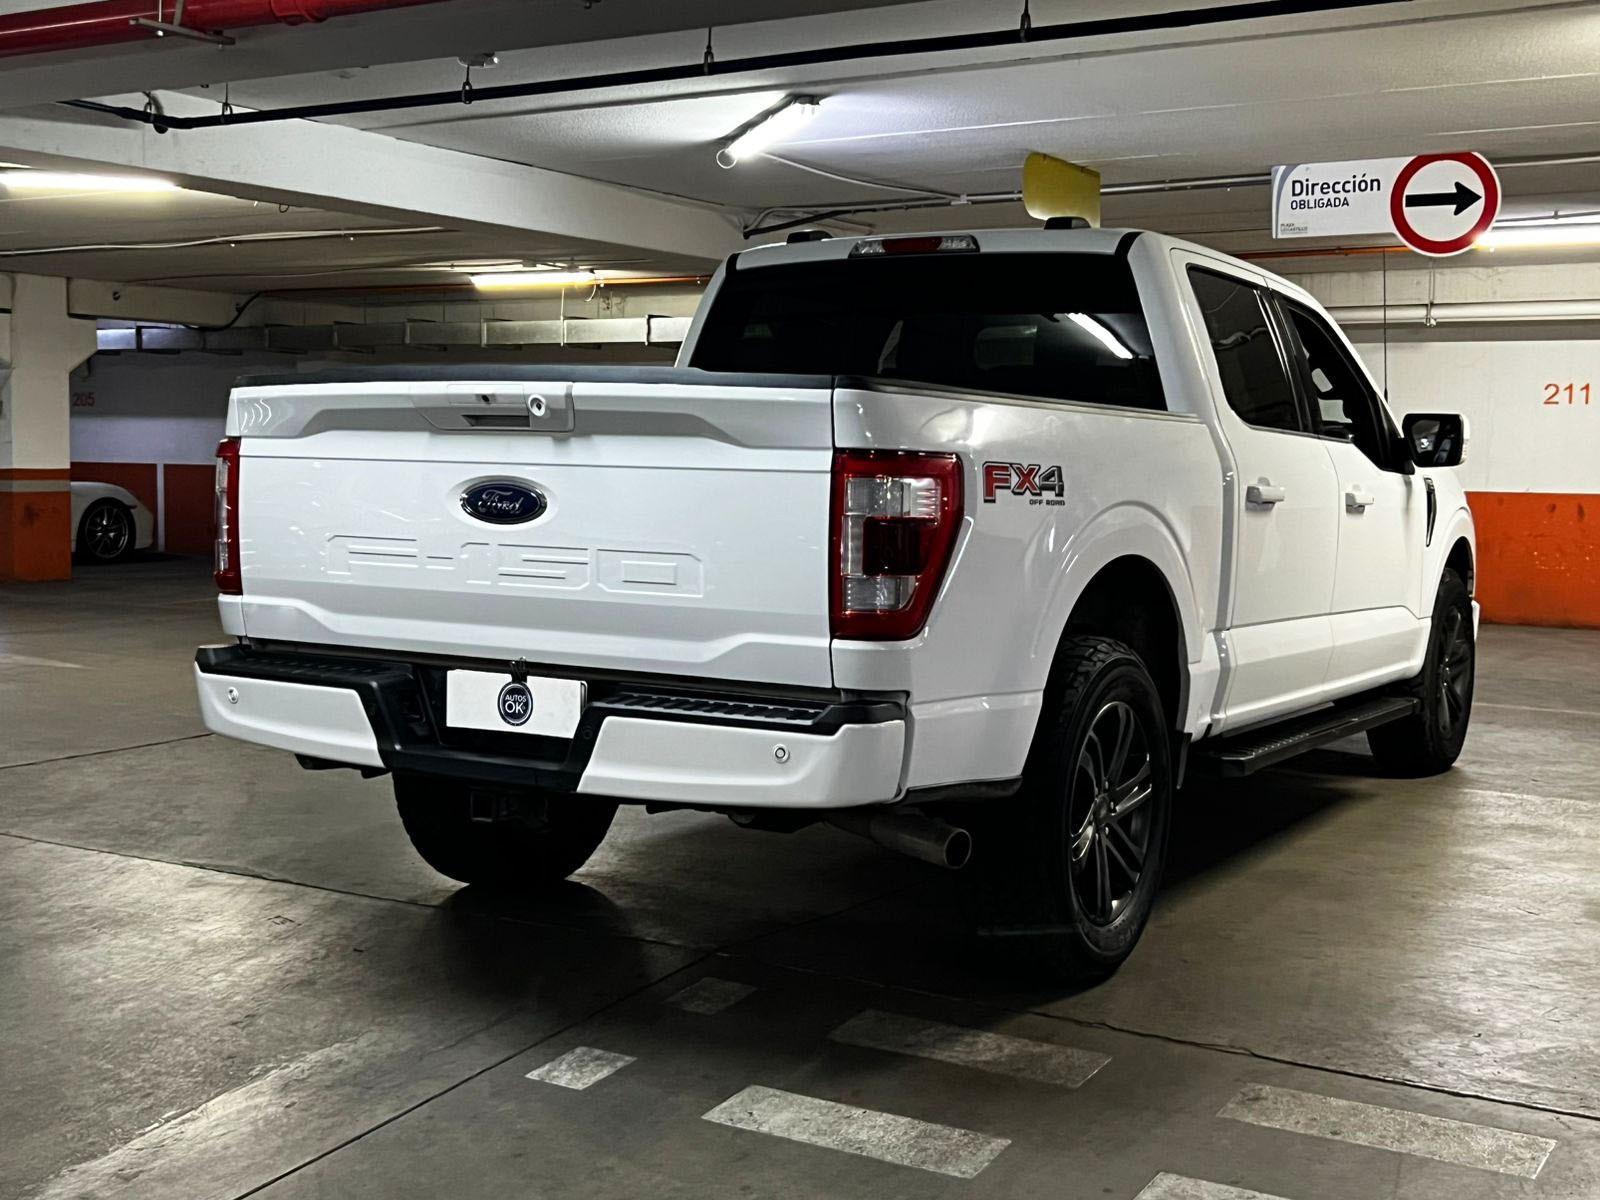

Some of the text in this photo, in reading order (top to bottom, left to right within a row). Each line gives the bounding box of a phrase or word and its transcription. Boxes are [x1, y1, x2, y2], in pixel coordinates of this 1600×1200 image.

[1291, 173, 1381, 197] Dirección
[1290, 196, 1350, 211] OBLIGADA
[72, 392, 96, 407] 205
[1543, 383, 1590, 404] 211
[982, 461, 1064, 503] FX4
[478, 489, 524, 514] Ford
[321, 533, 704, 598] F-150
[505, 694, 526, 702] AUTOS
[505, 701, 524, 713] OK
